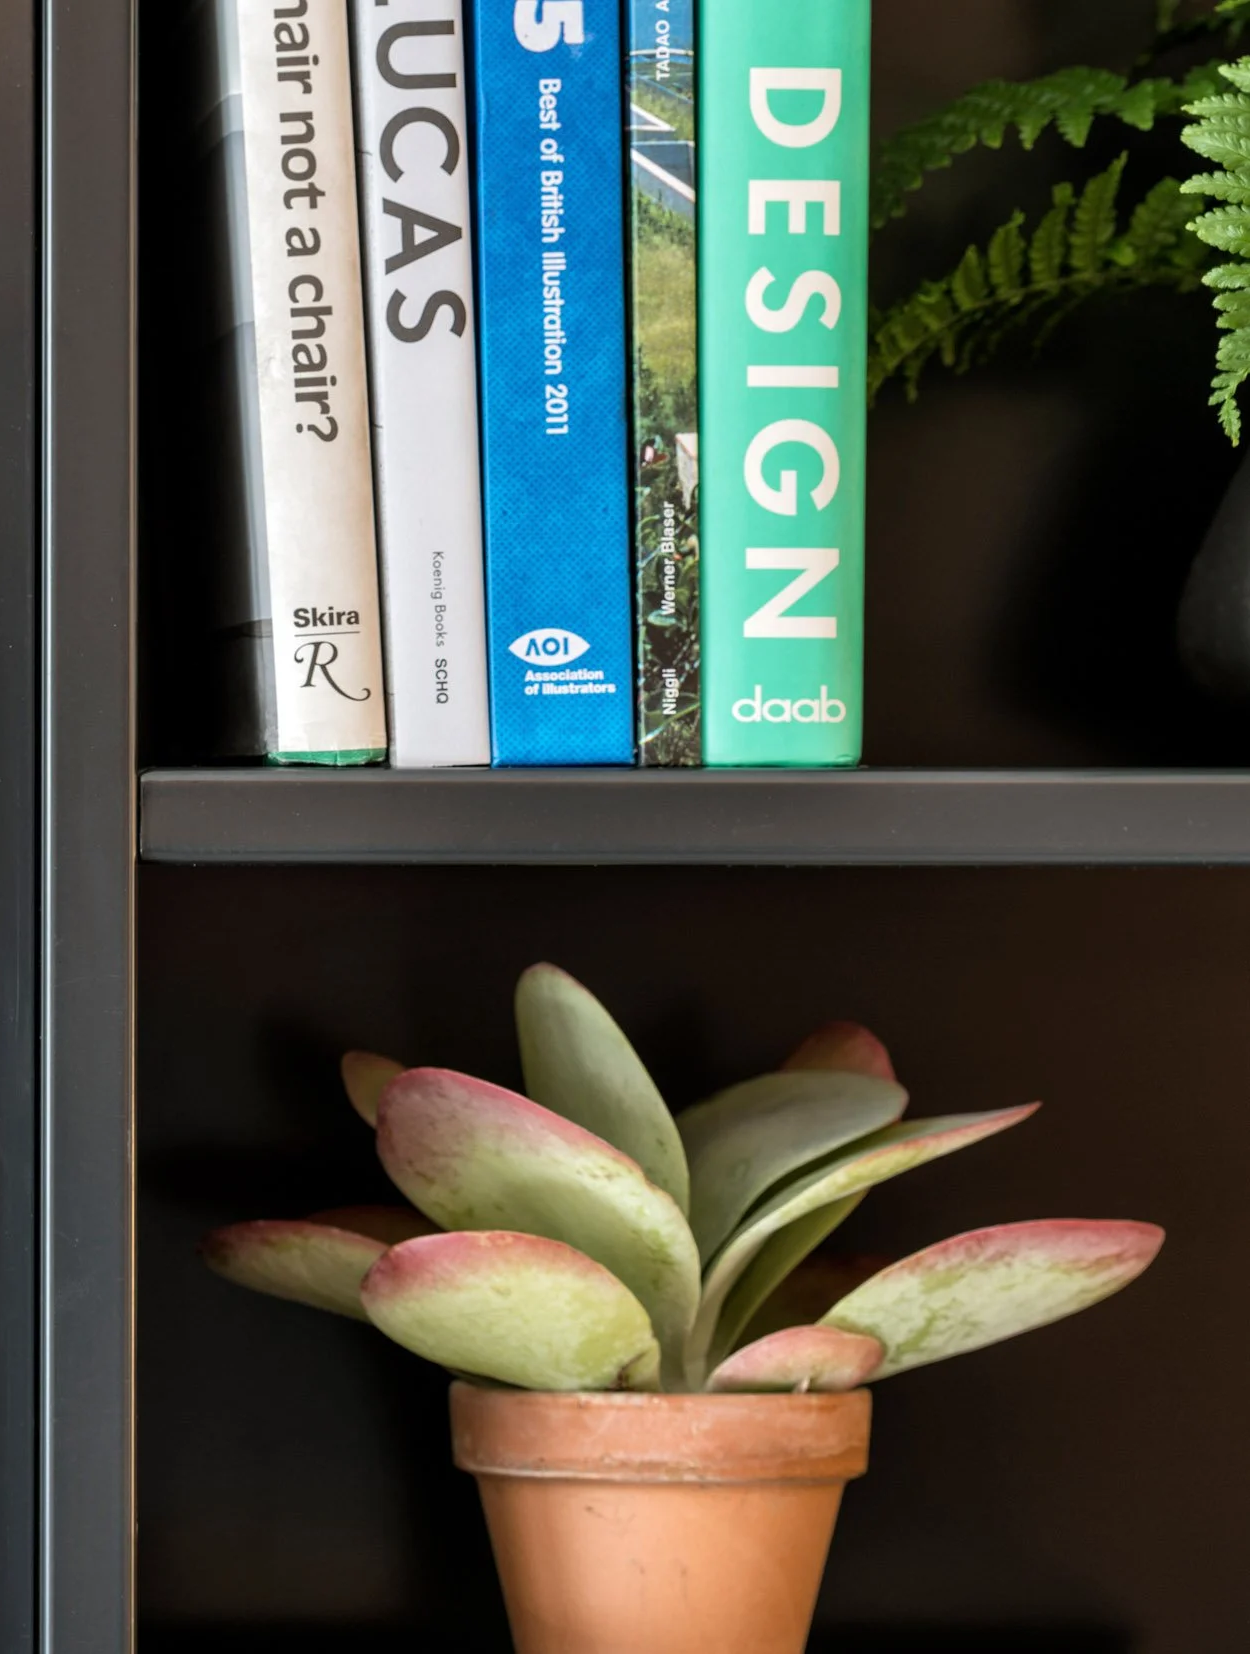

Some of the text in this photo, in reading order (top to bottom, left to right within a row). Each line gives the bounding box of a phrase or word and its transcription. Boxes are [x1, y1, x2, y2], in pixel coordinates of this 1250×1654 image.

[655, 20, 671, 81] TADAO
[279, 111, 326, 210] not
[375, 0, 468, 344] UCAS
[285, 227, 322, 258] a
[538, 78, 569, 435] Best of British Illustration 2011
[287, 274, 340, 443] chair?
[744, 67, 843, 639] DESIGN
[660, 501, 676, 615] Werner Blaser
[293, 606, 360, 628] Skira
[430, 551, 450, 704] Koenig Books SCHQ
[524, 668, 604, 682] Association
[524, 683, 540, 695] of
[661, 668, 680, 715] Niggli
[731, 684, 847, 725] daab
